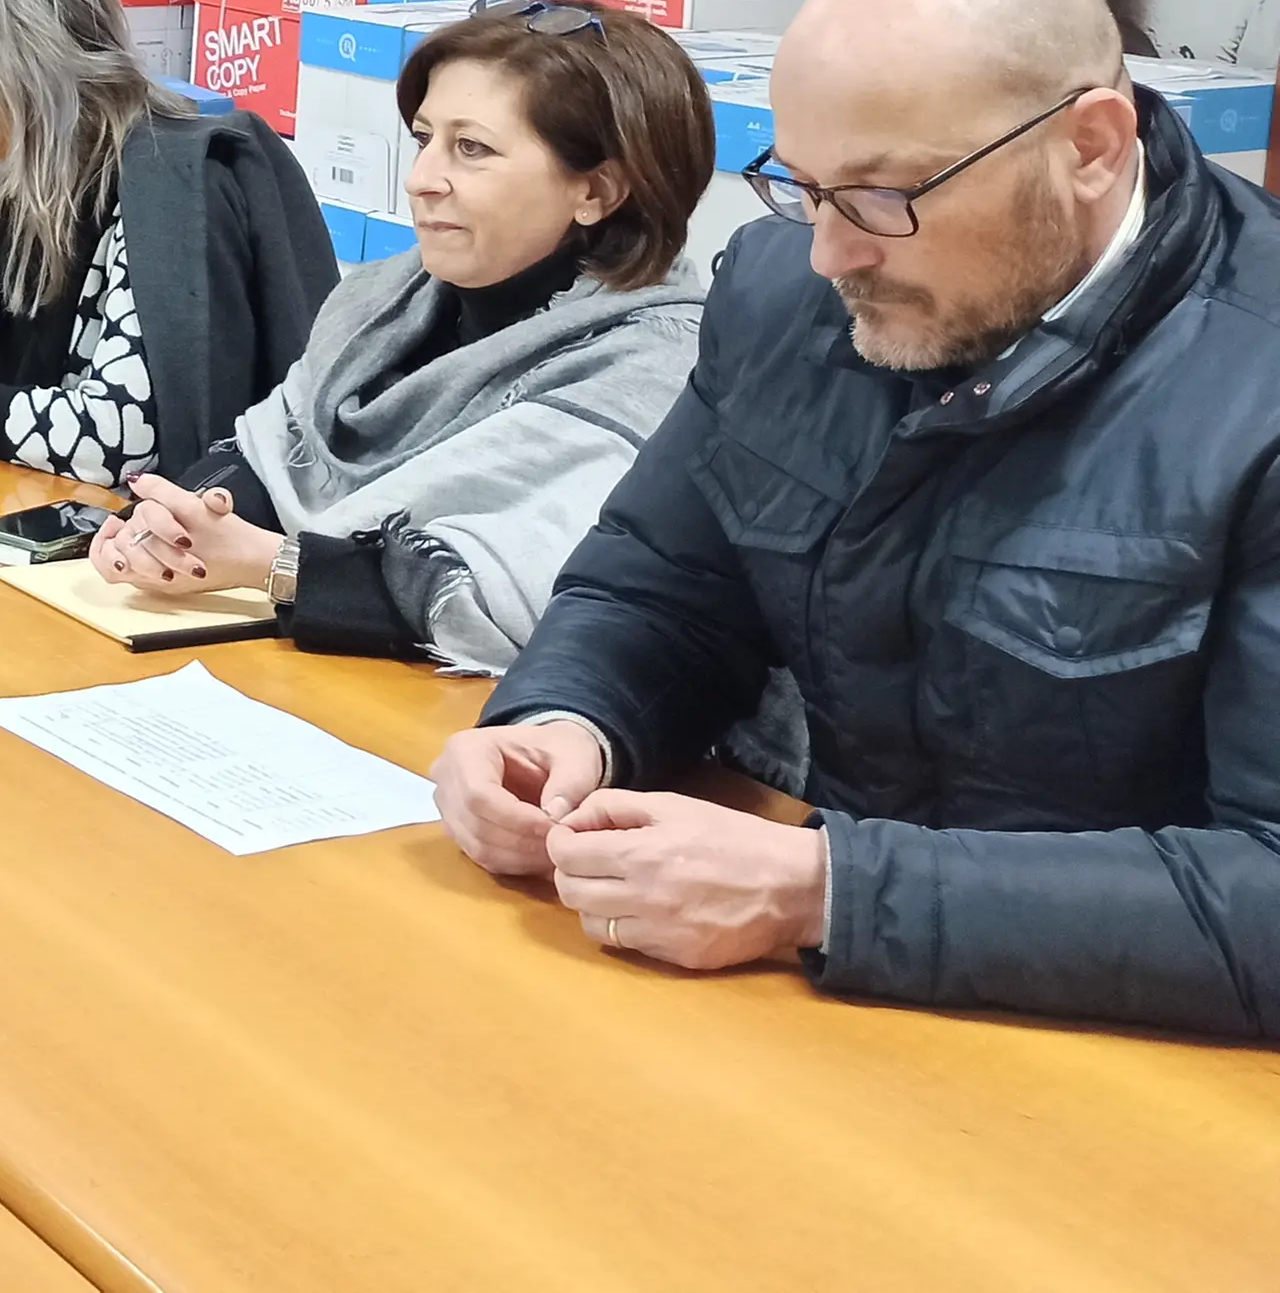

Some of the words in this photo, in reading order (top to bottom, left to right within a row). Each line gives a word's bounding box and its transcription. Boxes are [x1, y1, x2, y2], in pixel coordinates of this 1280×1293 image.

[205, 17, 283, 62] SMART
[206, 54, 260, 91] COPY
[233, 86, 249, 98] Copy
[249, 82, 267, 95] Paper
